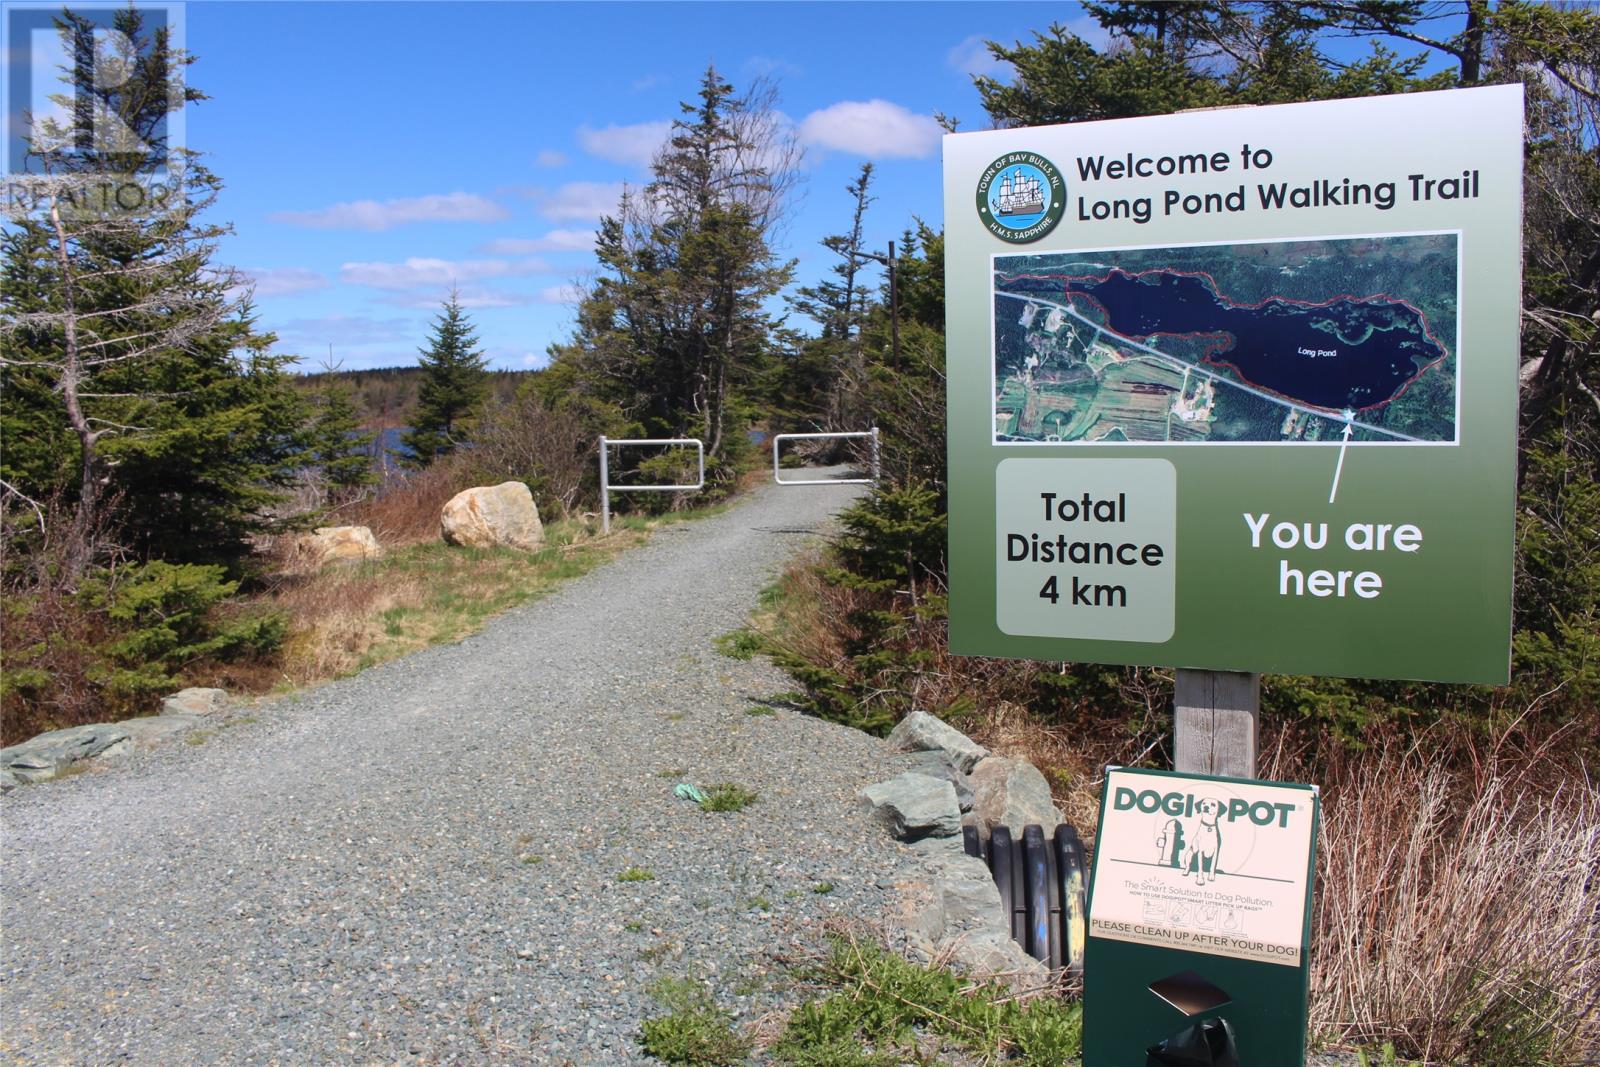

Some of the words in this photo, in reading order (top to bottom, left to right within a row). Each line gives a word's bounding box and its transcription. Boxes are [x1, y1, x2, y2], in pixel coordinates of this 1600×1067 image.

[978, 168, 996, 193] TOWN
[995, 158, 1007, 169] OF
[1008, 154, 1027, 163] BAY
[1051, 176, 1060, 189] NL
[1076, 151, 1231, 182] Welcome
[1240, 144, 1273, 170] to
[1078, 196, 1152, 224] Long
[1164, 186, 1246, 216] Pond
[1257, 178, 1396, 211] Walking
[1408, 170, 1480, 202] Trail
[989, 222, 1013, 239] H.M.S.
[1014, 216, 1053, 240] SAPPHIRE
[1298, 346, 1316, 358] Long
[1317, 349, 1337, 357] Pond
[1041, 492, 1126, 522] Total
[1007, 533, 1164, 566] Distance
[1243, 513, 1328, 550] You
[1345, 523, 1423, 552] are
[1039, 575, 1060, 604] 4
[1072, 576, 1127, 607] km
[1279, 559, 1383, 599] here
[1124, 880, 1139, 890] The
[1140, 882, 1167, 894] Smart
[1168, 886, 1203, 898] Solution
[1204, 891, 1214, 899] to
[1215, 892, 1233, 903] Dog
[1092, 919, 1131, 932] PLEASE
[1134, 925, 1171, 938] CLEAN
[1174, 931, 1190, 940] UP
[1192, 934, 1228, 946] AFTER
[1231, 939, 1264, 952] YOUR
[1267, 944, 1298, 957] DOG!
